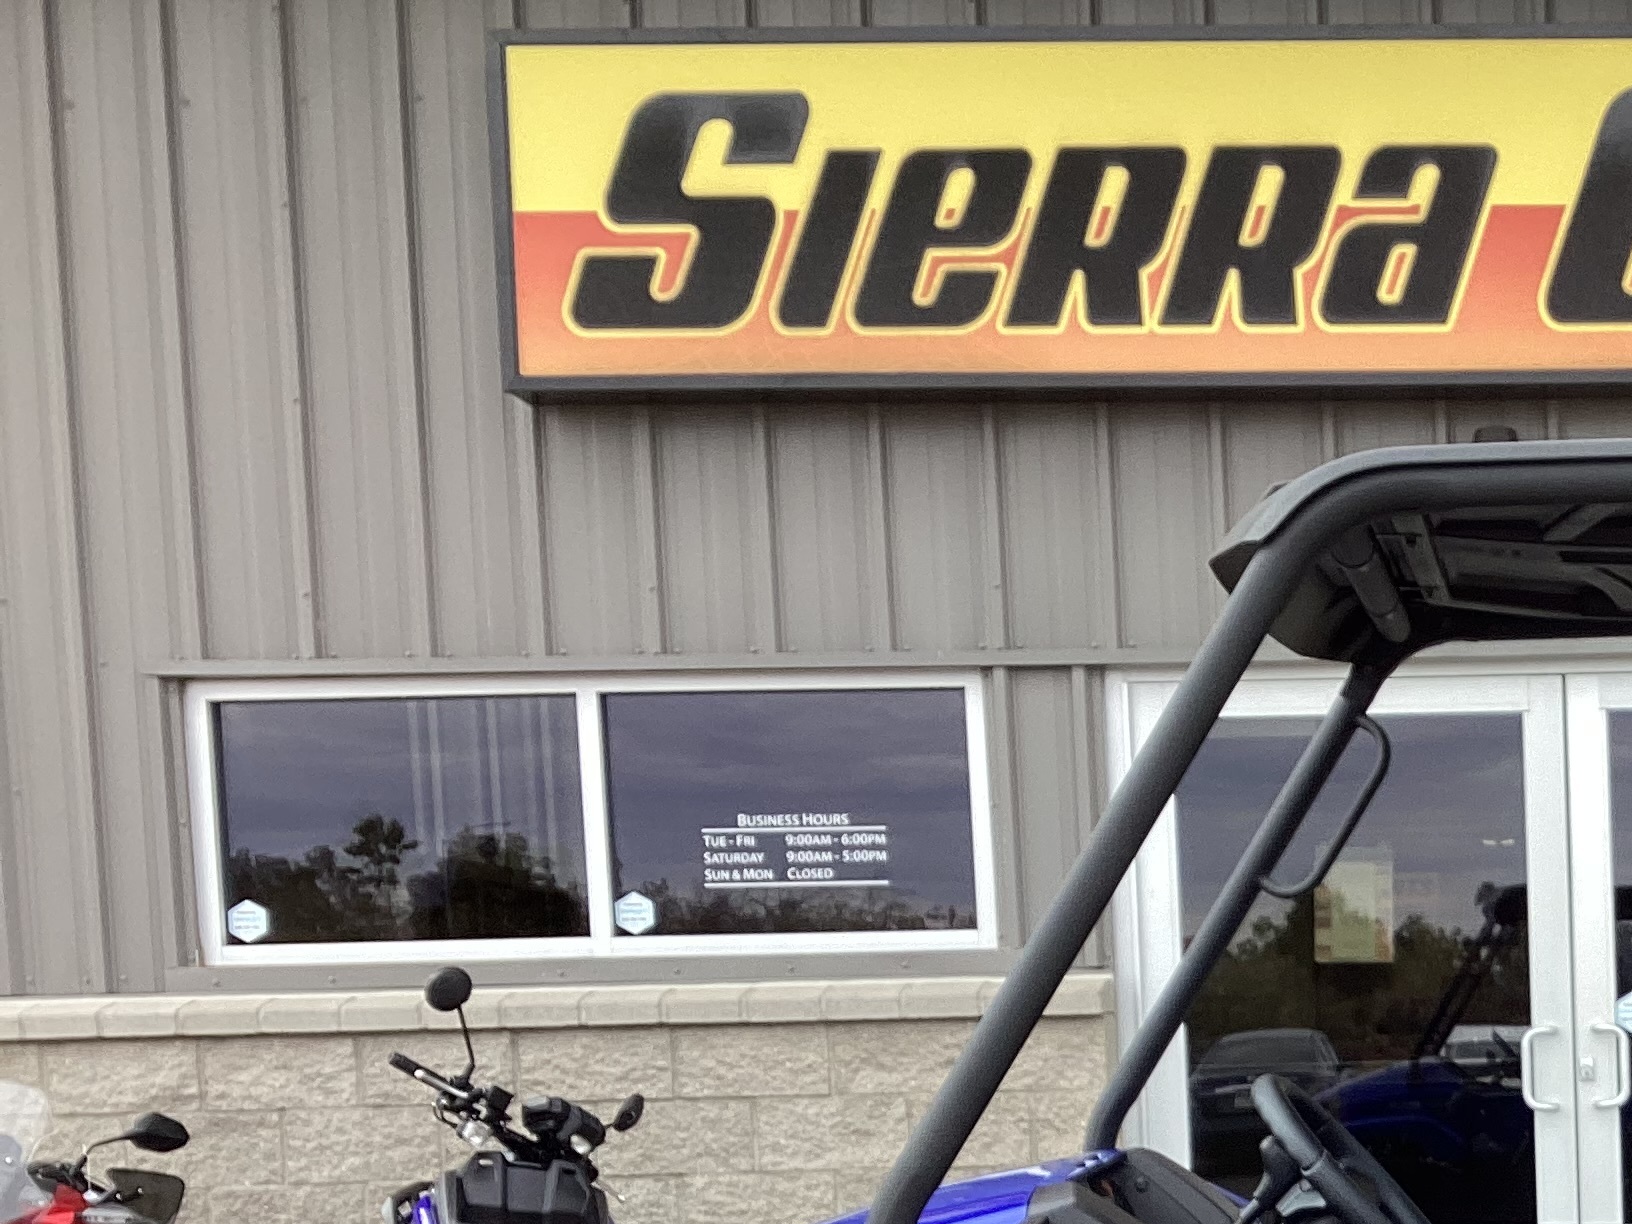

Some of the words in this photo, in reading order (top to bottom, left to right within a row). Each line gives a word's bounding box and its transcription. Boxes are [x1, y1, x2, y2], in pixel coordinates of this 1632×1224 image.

[703, 835, 726, 848] TUE
[736, 835, 755, 847] FRI
[785, 834, 832, 847] 9:00AM
[841, 833, 886, 846] 6:00PM
[703, 852, 765, 865] SATURDAY
[786, 851, 833, 863] 9:00AM
[841, 850, 887, 862] 5:00PM
[704, 868, 729, 881] SUN
[731, 869, 740, 880] &
[743, 868, 773, 880] MON
[787, 867, 834, 880] CLOSED
